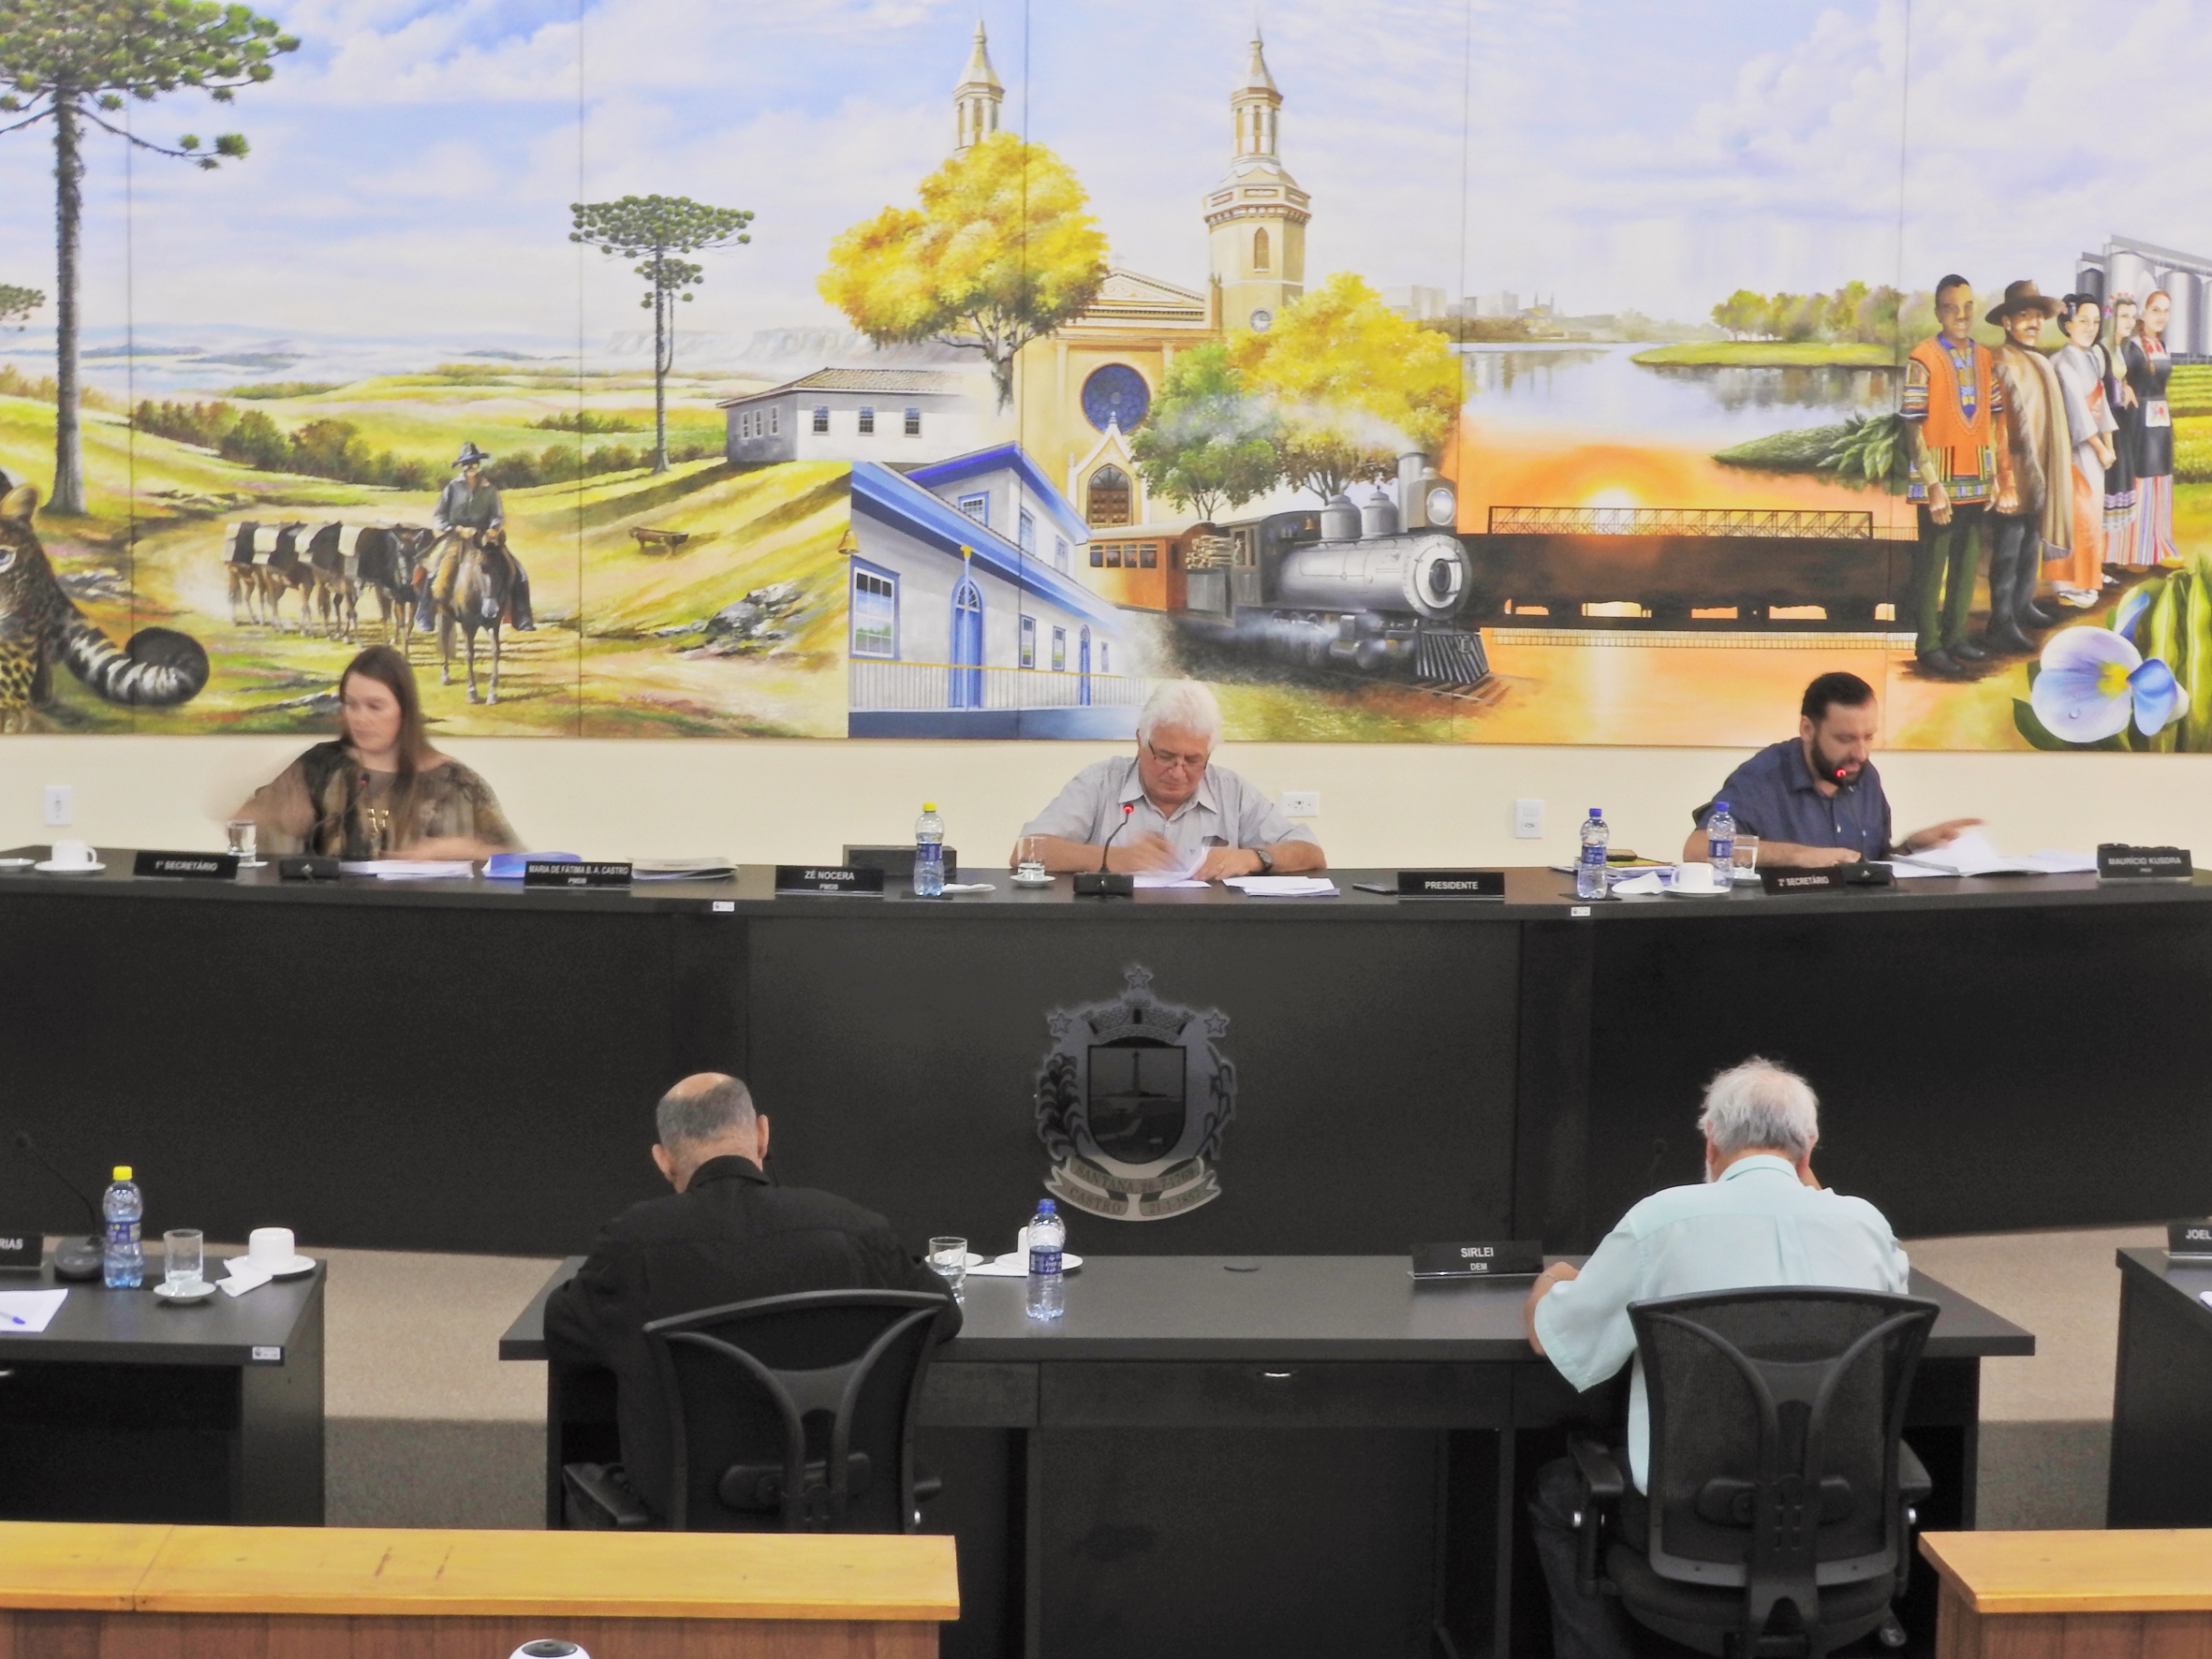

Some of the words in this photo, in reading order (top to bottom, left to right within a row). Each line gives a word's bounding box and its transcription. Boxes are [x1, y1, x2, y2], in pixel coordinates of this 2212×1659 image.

[164, 859, 218, 872] SECRETÁRIO
[528, 864, 550, 874] MARIA
[551, 865, 561, 874] DE
[561, 864, 585, 874] FÁTIMA
[601, 866, 629, 875] CASTRO
[804, 869, 817, 879] ZÉ
[818, 871, 855, 880] NOCERA
[1424, 881, 1479, 889] PRESIDENTE
[1069, 1188, 1121, 1214] CASTRO
[2185, 1228, 2212, 1240] JOEL
[1461, 1247, 1495, 1258] SIRLEI
[1469, 1262, 1488, 1270] DEM
